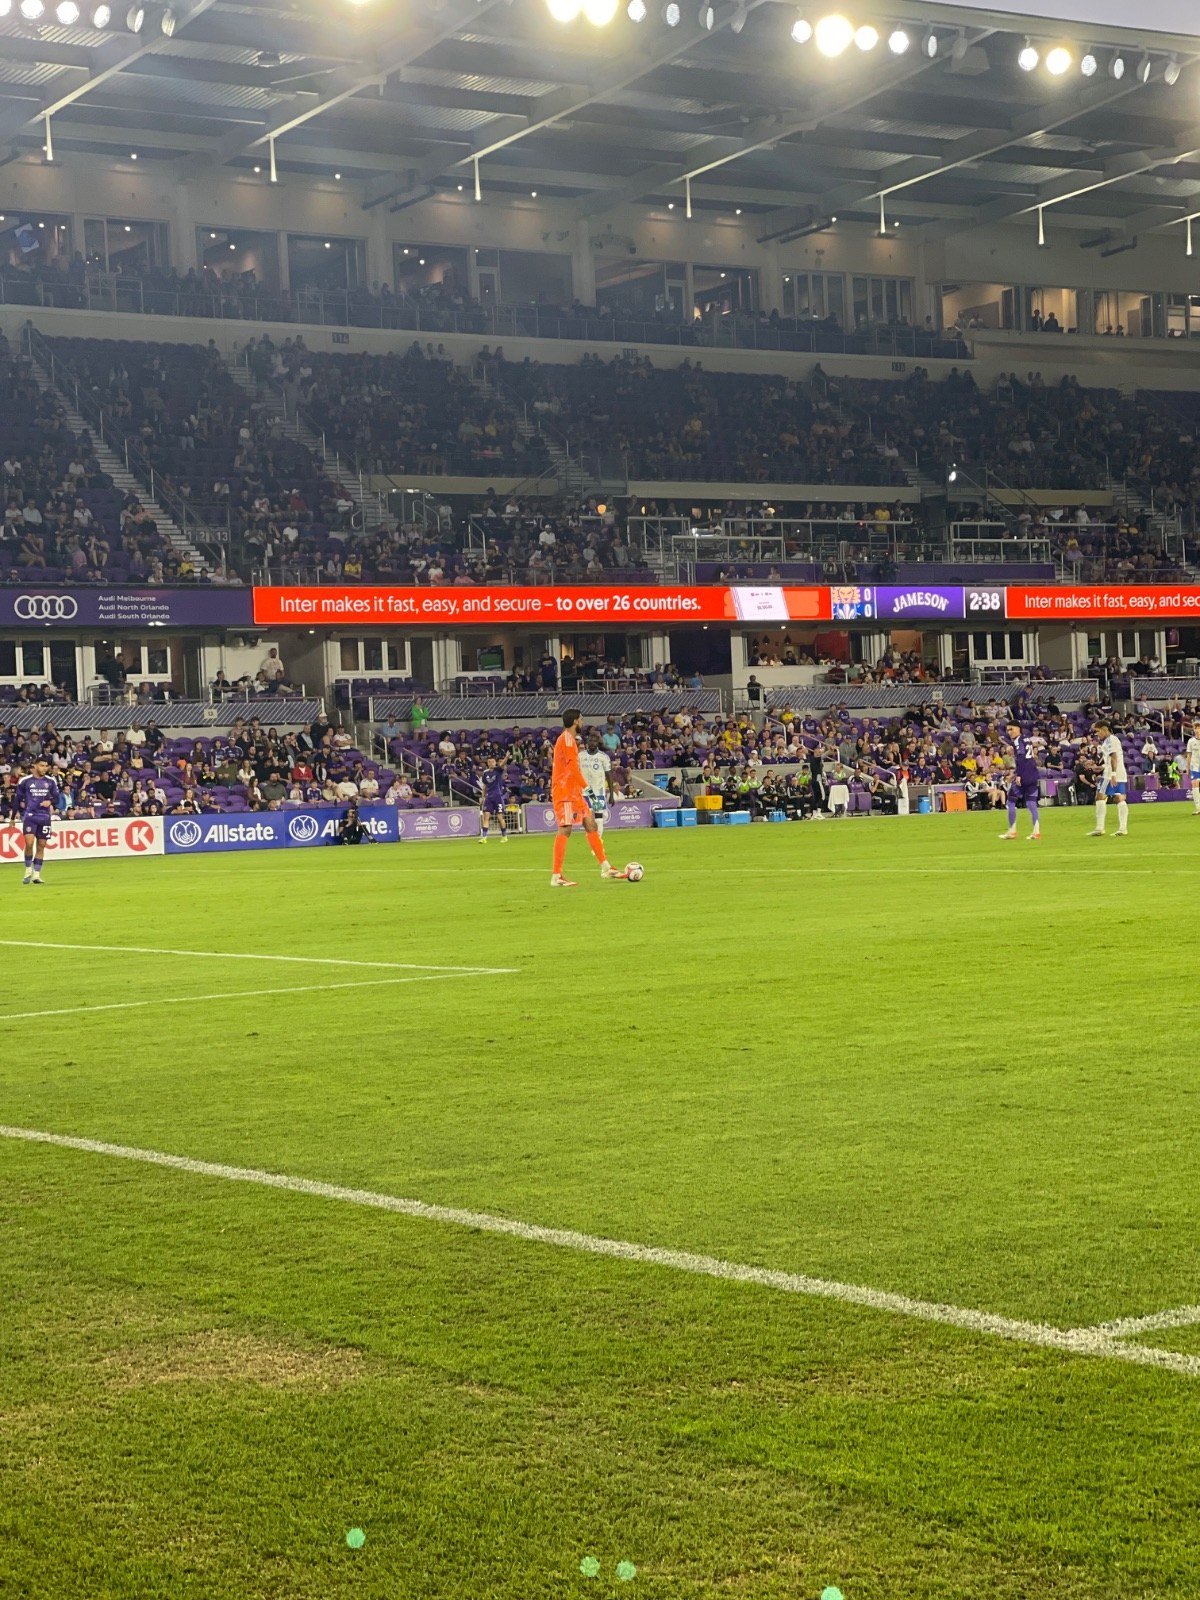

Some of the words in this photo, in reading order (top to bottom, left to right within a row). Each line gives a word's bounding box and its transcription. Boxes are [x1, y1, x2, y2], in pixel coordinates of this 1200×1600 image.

[864, 588, 871, 602] 0
[892, 591, 948, 613] JAMESON
[969, 592, 1001, 611] 2:38
[1025, 595, 1053, 609] Inter
[1056, 595, 1089, 608] makes
[1091, 594, 1101, 608] it
[1103, 594, 1127, 609] fast,
[1129, 596, 1158, 610] easy,
[1159, 593, 1181, 607] and
[1182, 595, 1200, 607] sec
[281, 596, 318, 612] Inter
[322, 596, 370, 612] makes
[374, 596, 384, 612] it
[387, 596, 419, 613] fast,
[422, 599, 460, 616] easy,
[463, 595, 490, 611] and
[494, 599, 541, 612] secure
[555, 597, 573, 611] to
[576, 599, 609, 611] over
[613, 596, 630, 611] 26
[633, 594, 702, 611] countries.
[864, 603, 872, 618] 0
